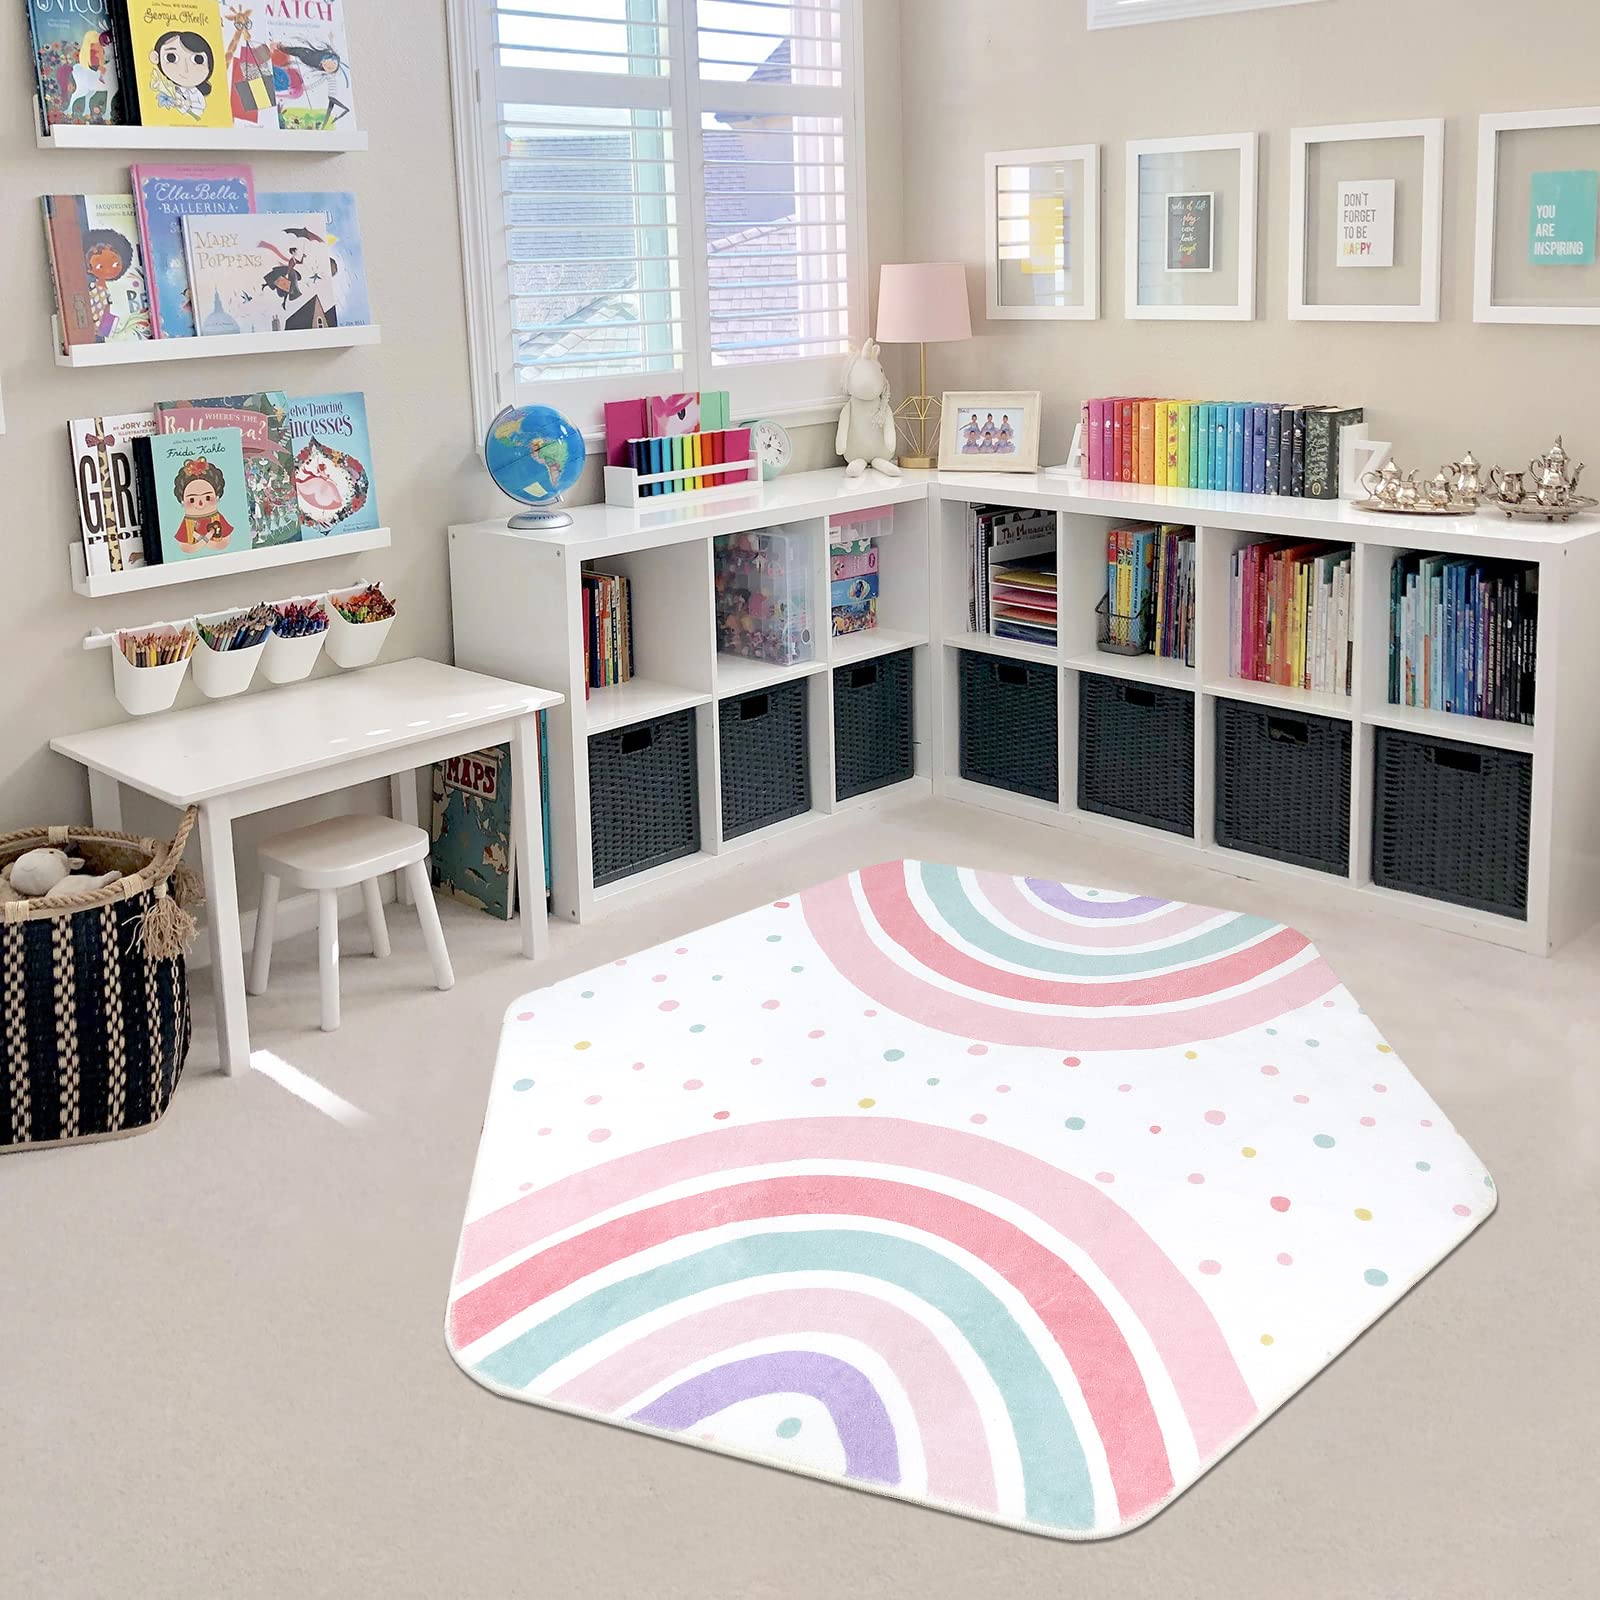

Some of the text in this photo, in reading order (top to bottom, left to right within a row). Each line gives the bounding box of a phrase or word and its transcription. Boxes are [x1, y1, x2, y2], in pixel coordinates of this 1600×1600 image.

[143, 8, 178, 27] Georgia
[154, 183, 240, 201] Ella Bella
[1344, 192, 1369, 207] DON'T
[1344, 209, 1377, 223] FORGET
[1536, 204, 1556, 219] YOU
[1344, 226, 1368, 239] TO BE
[1535, 223, 1556, 237] ARE
[194, 231, 239, 248] MARY
[1534, 241, 1584, 256] INSPIRING
[195, 252, 264, 269] POPPINS
[307, 401, 344, 417] Dancing
[120, 421, 141, 430] JORY
[204, 413, 257, 423] WHERE'S THE
[166, 443, 226, 458] Frida Kahlo
[447, 757, 496, 793] MAPS
